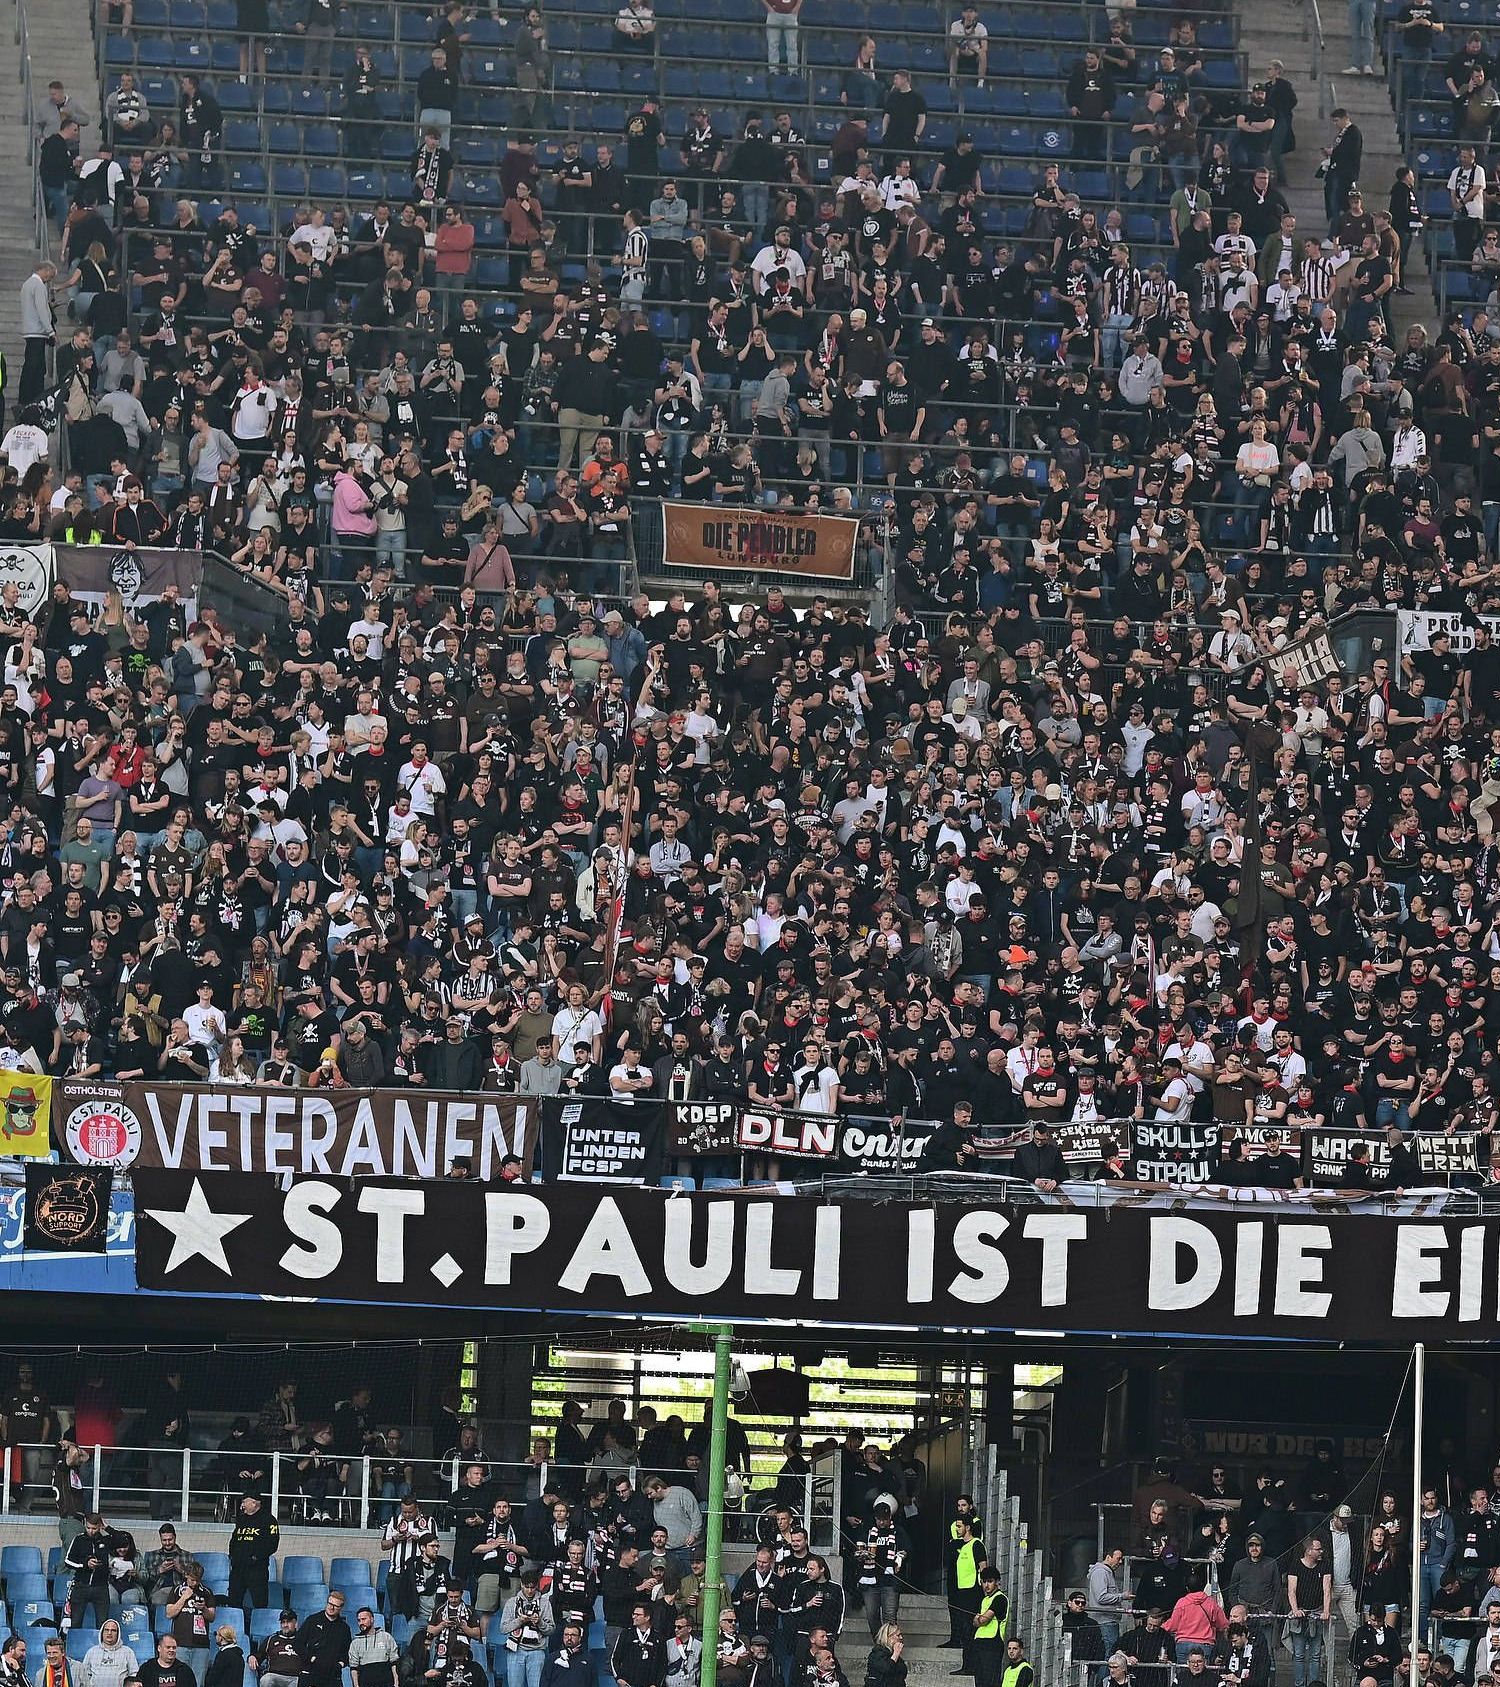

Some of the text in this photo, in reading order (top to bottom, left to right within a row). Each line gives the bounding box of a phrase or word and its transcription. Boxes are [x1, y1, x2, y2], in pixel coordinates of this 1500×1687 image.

[702, 521, 817, 556] DIE PENDLER
[64, 1085, 122, 1098] OSTHOLSTEIN
[69, 1114, 82, 1132] FC
[103, 1102, 139, 1136] PAULI
[676, 1104, 732, 1124] KDSP
[144, 1091, 528, 1186] VETERANEN
[571, 1129, 641, 1145] UNTER
[739, 1113, 836, 1153] DLN
[1136, 1124, 1218, 1149] SKULLS
[569, 1144, 646, 1160] LINDEN
[1419, 1137, 1474, 1154] METT
[568, 1160, 623, 1174] FCSP
[860, 1158, 918, 1169] Sankt Puli
[1421, 1154, 1477, 1171] CREW
[48, 1212, 86, 1223] NORD
[48, 1222, 83, 1230] SUPPORT
[907, 1207, 1088, 1308] IST
[1148, 1216, 1334, 1318] DIE
[1204, 1432, 1268, 1454] NUR
